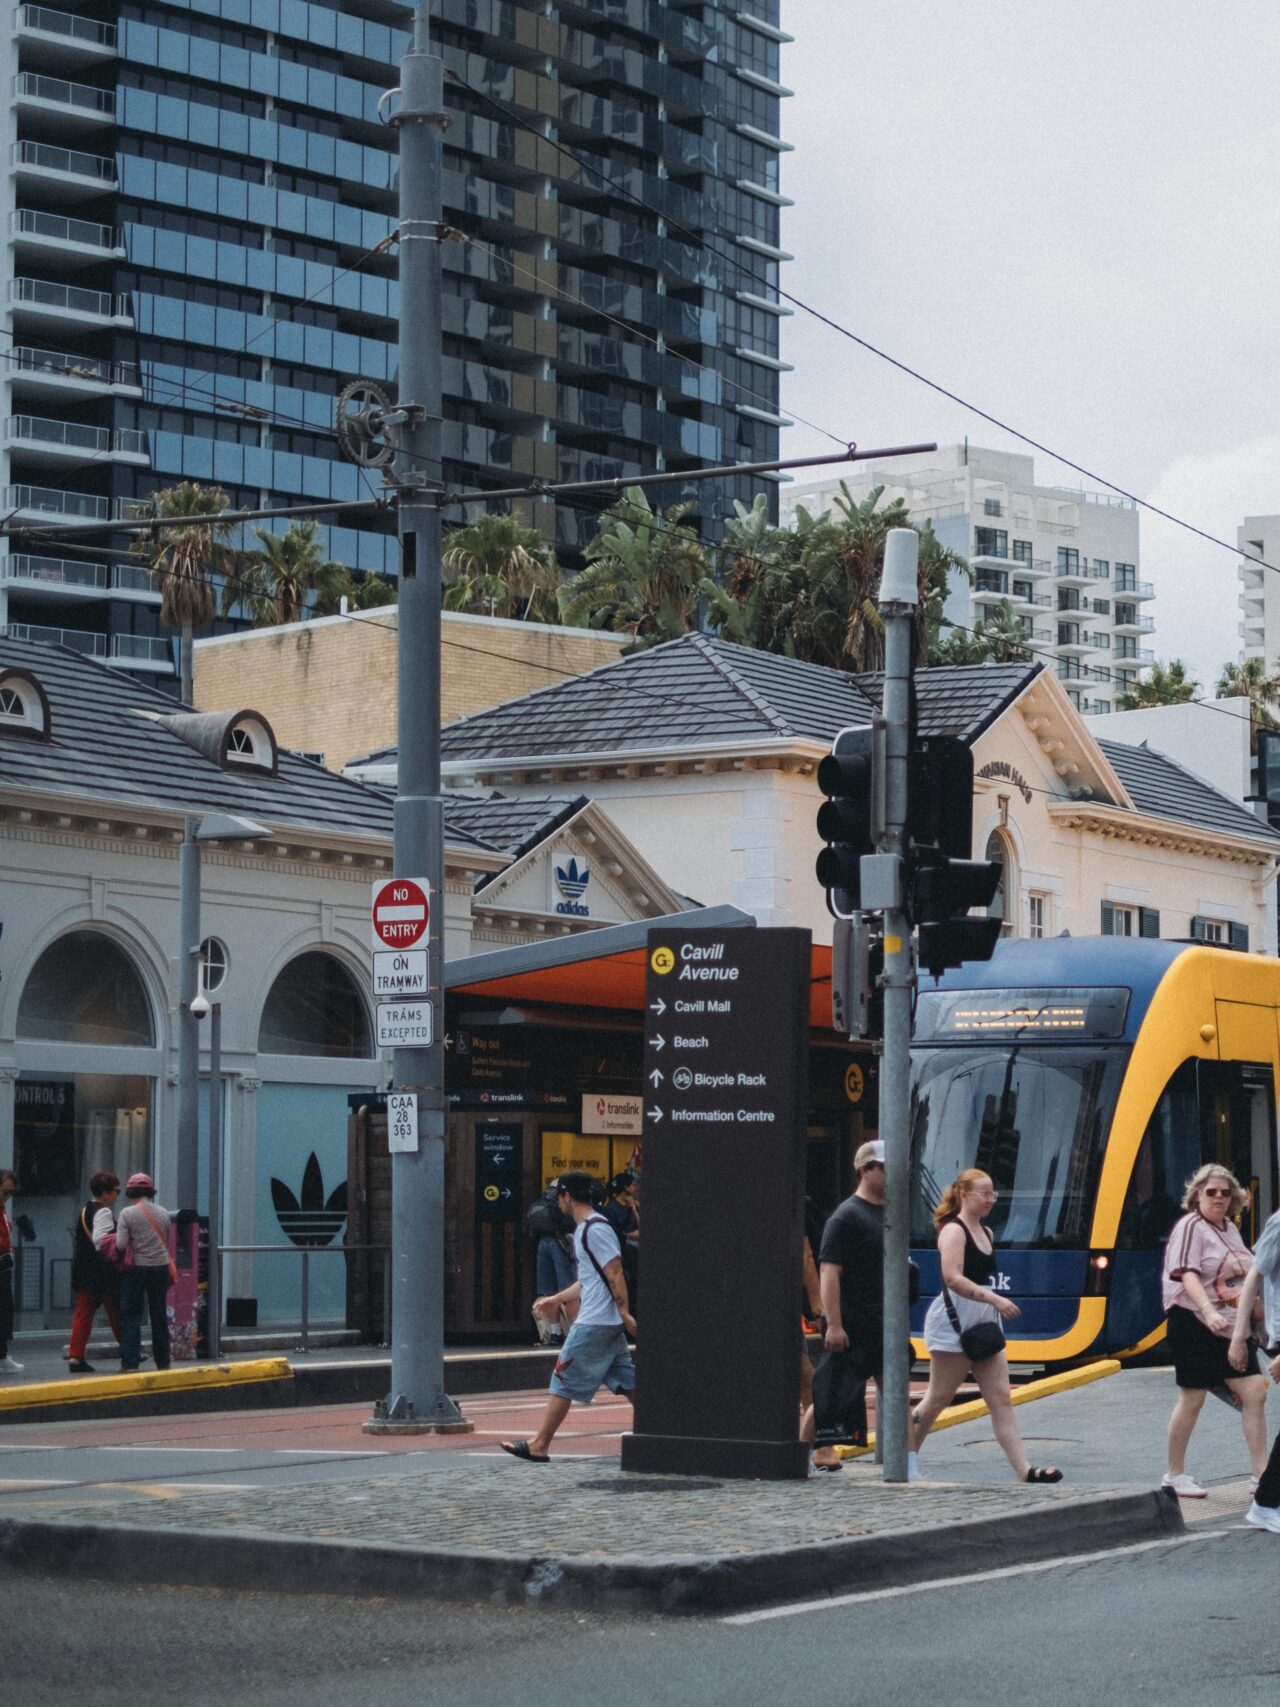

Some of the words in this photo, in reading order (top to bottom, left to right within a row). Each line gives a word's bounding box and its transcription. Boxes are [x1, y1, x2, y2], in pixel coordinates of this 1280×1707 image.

[393, 888, 409, 901] NO
[556, 900, 589, 917] adidas
[383, 923, 418, 938] ENTRY
[680, 944, 724, 960] Cavill
[393, 957, 409, 971] ON
[679, 964, 739, 981] Avenue
[377, 974, 424, 989] TRAMWAY
[674, 1001, 704, 1012] Cavill
[707, 1000, 731, 1012] Mall
[386, 1010, 422, 1021] TRAMS
[381, 1027, 427, 1039] EXCEPTED
[674, 1036, 709, 1048] Beach
[694, 1074, 734, 1087] Bicycle
[738, 1074, 766, 1085] Rack
[15, 1085, 55, 1104] ONTROL
[491, 1093, 524, 1102] translink
[391, 1096, 413, 1109] CAA
[607, 1103, 639, 1116] translink
[671, 1109, 734, 1121] Information
[737, 1110, 775, 1122] Centre
[396, 1111, 408, 1123] 28
[394, 1124, 412, 1136] 363
[483, 1133, 511, 1142] Service
[483, 1143, 514, 1151] window
[552, 1157, 567, 1168] Find
[569, 1158, 584, 1169] your
[585, 1159, 599, 1170] way
